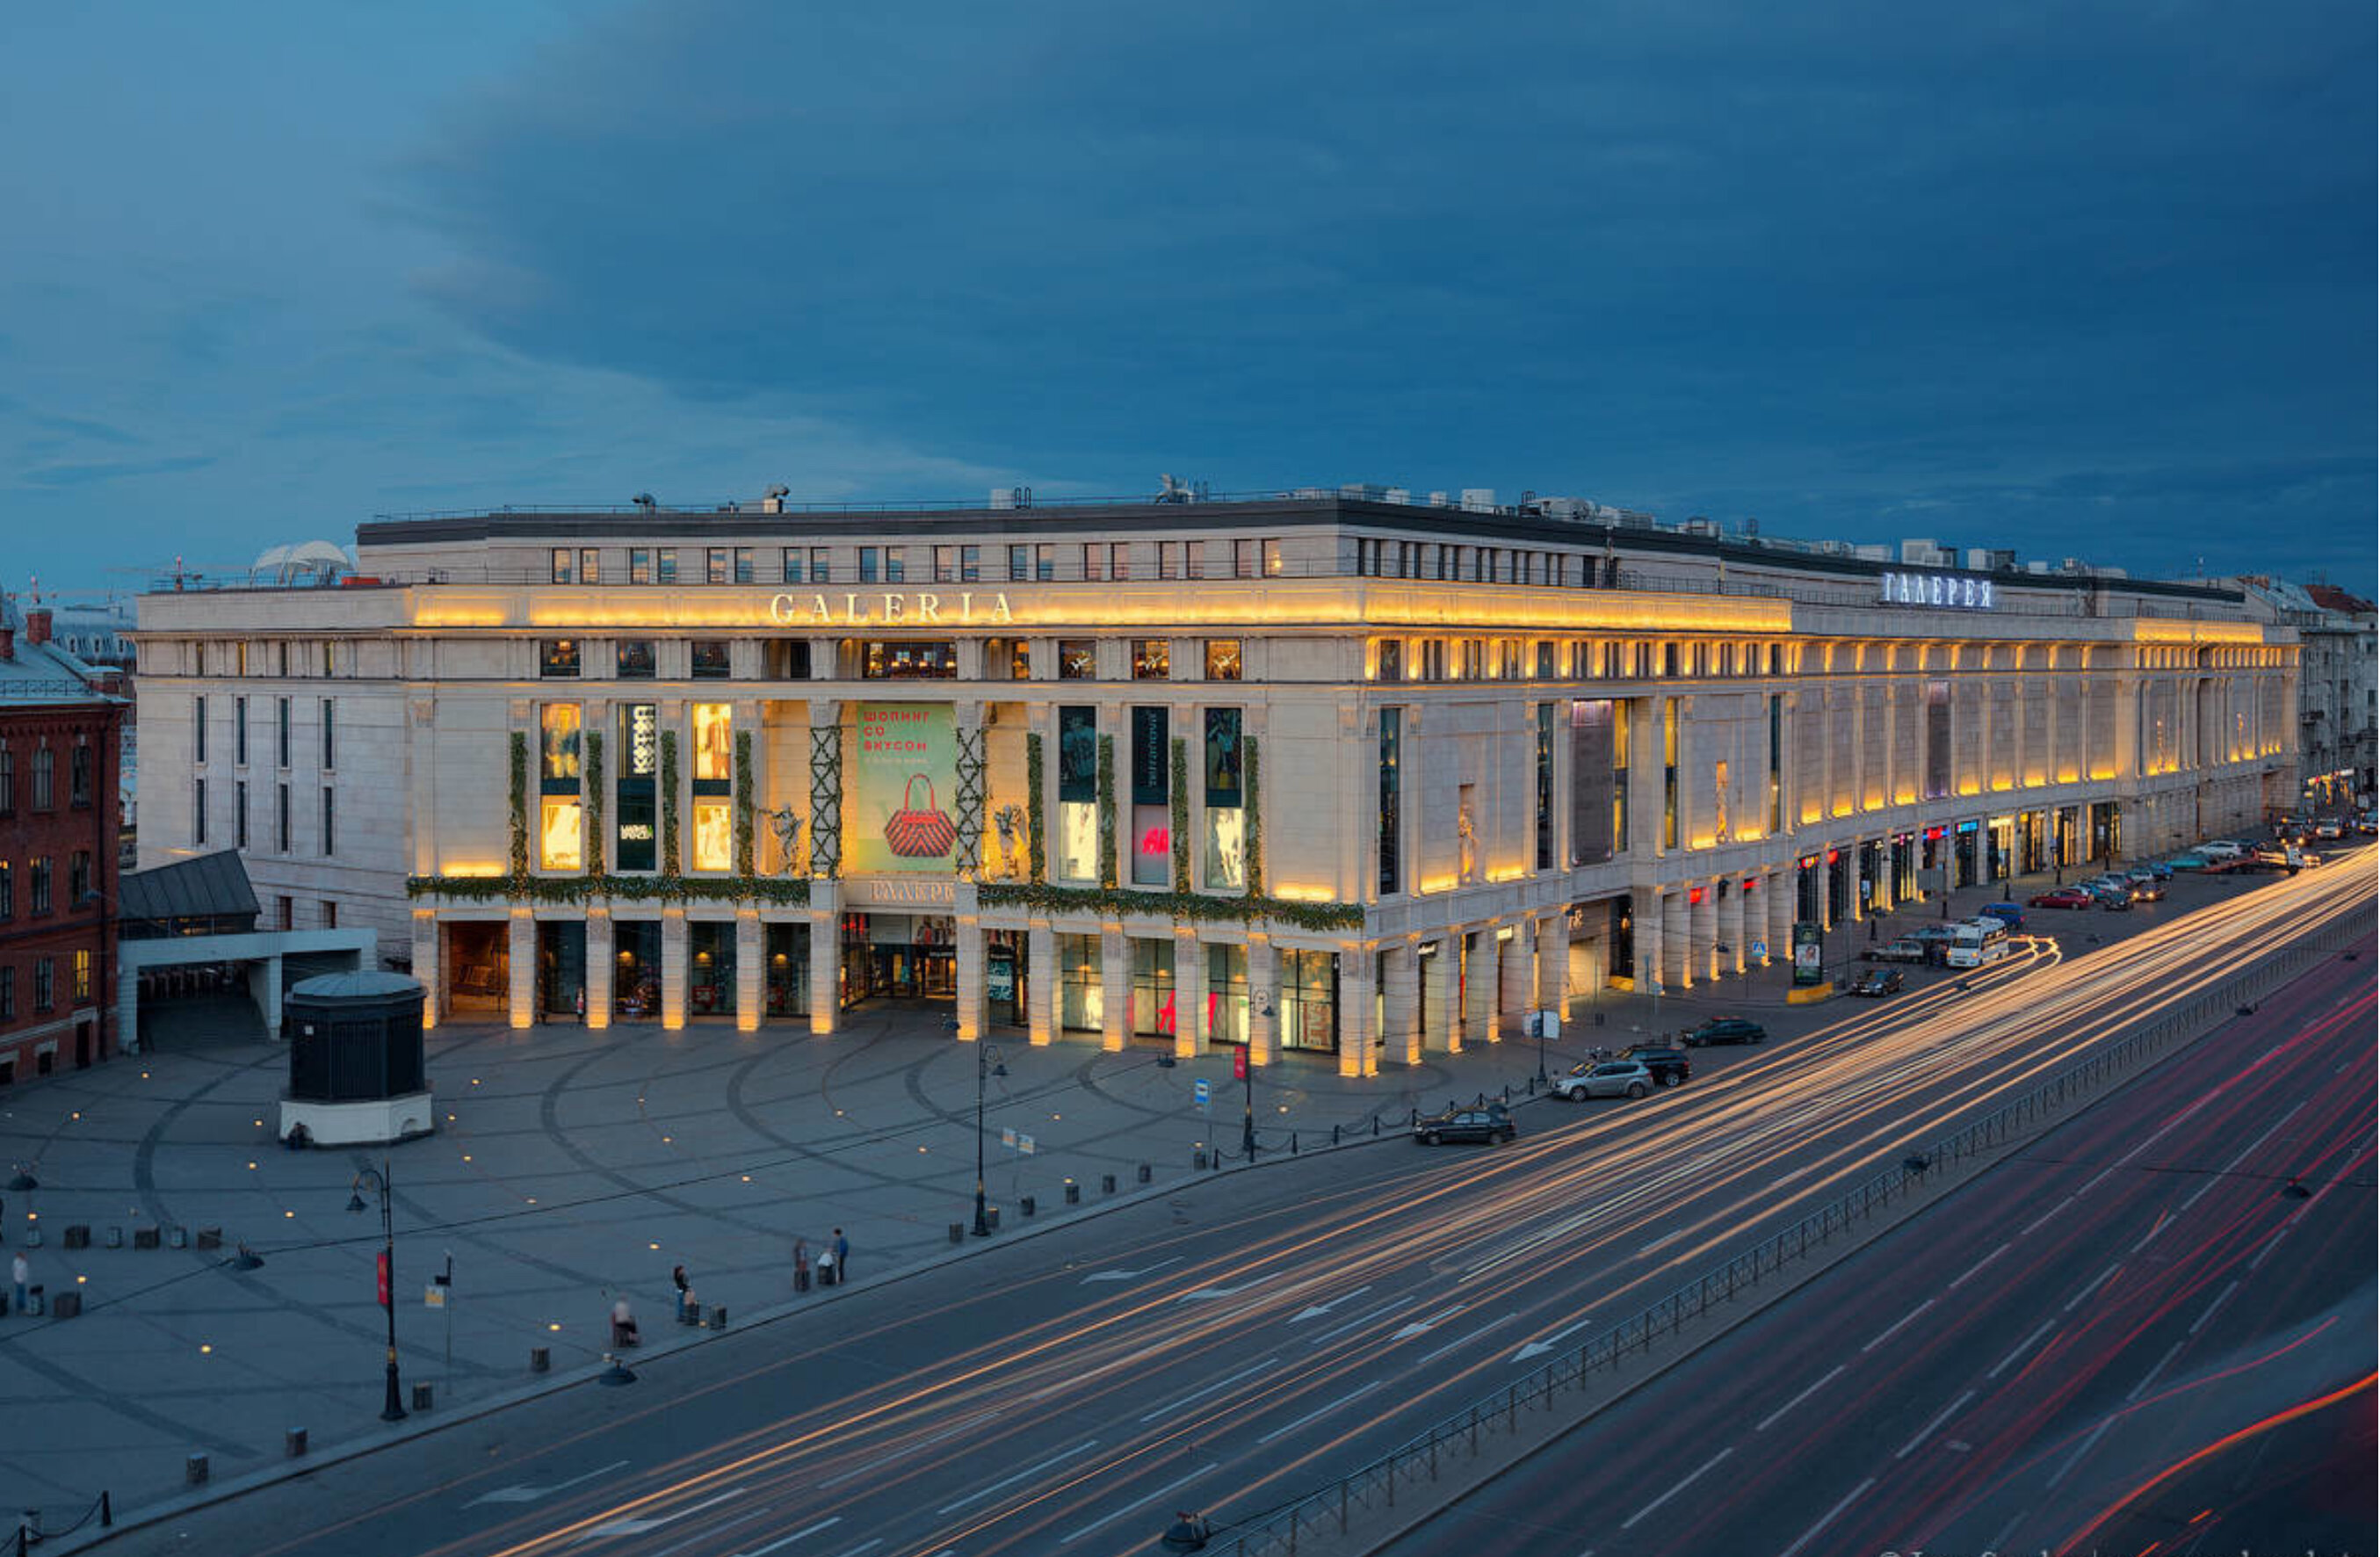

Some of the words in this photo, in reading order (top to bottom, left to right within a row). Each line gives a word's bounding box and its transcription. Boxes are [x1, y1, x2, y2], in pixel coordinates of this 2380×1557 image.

[1884, 572, 1992, 607] ГАЛЕРЕЯ
[770, 592, 1013, 623] GALERIA
[864, 726, 885, 737] СО
